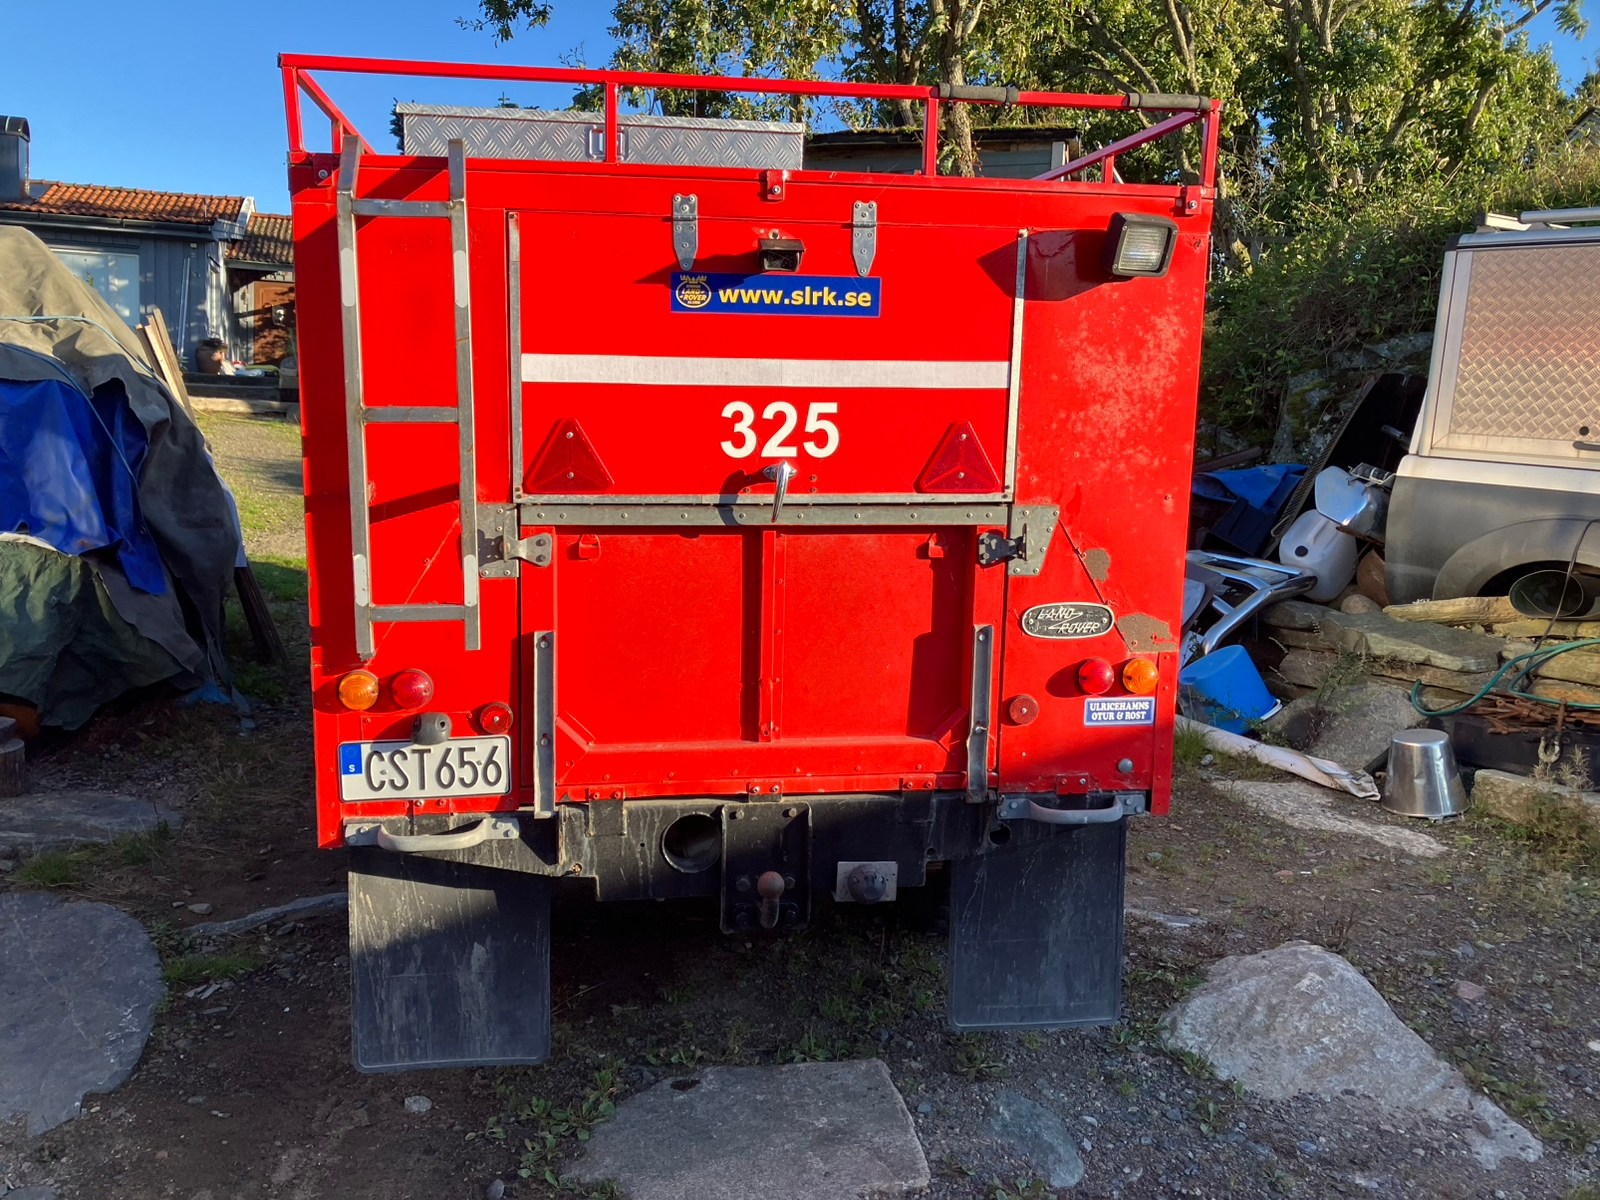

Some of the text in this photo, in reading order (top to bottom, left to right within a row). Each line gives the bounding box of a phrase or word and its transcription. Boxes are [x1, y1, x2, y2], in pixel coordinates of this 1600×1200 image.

[718, 286, 872, 307] www.slrk.se
[720, 400, 840, 459] 325
[1036, 605, 1076, 621] LAND
[1056, 621, 1100, 635] ROVER
[1089, 701, 1150, 711] ULRICEHAMNS
[1091, 710, 1147, 721] OTUR & ROST
[348, 763, 356, 773] S
[365, 745, 502, 792] CST656
